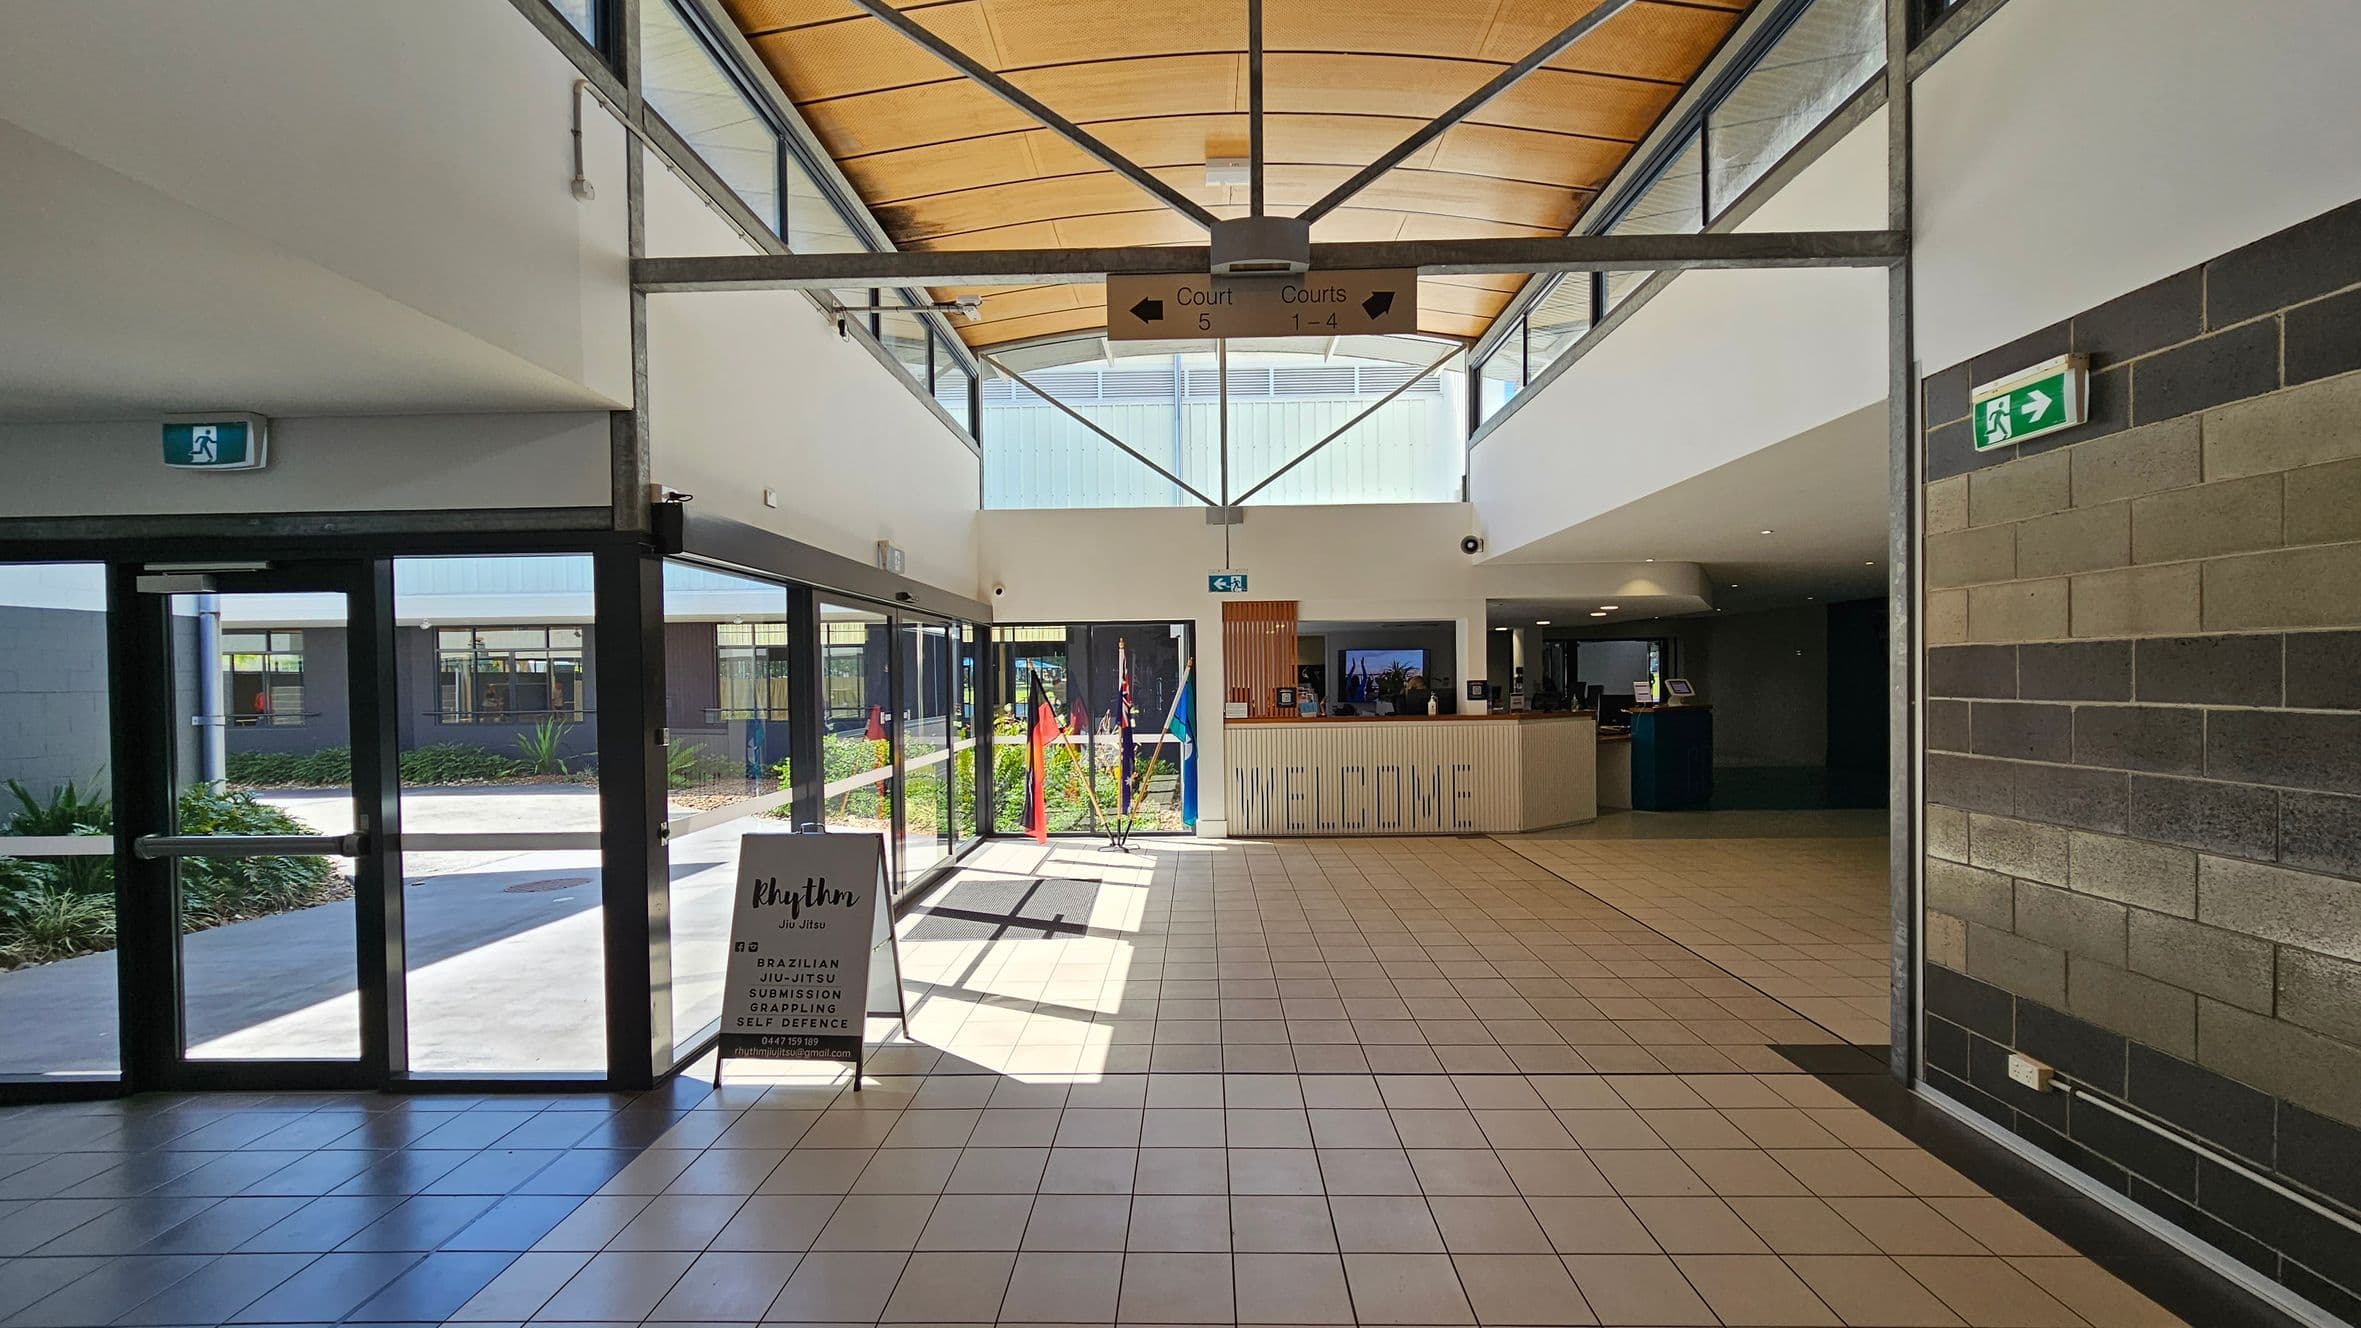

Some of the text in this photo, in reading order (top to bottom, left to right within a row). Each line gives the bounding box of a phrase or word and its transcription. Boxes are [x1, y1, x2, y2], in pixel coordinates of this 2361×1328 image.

[1177, 287, 1233, 306] Court
[1281, 285, 1347, 304] Courts
[1199, 313, 1211, 331] 5
[1292, 313, 1299, 331] 1
[1326, 312, 1338, 330] 4
[1236, 764, 1472, 830] WELCOME
[752, 877, 860, 920] Rhythm
[778, 920, 826, 930] Jiu Jitsu
[757, 958, 839, 968] BRAZILIAN
[760, 973, 836, 983] JIU-JITSU
[749, 988, 841, 999] SUBMISSION
[750, 1003, 836, 1013] GRAPPLING
[736, 1017, 848, 1029] SELF DEFENCE
[761, 1036, 819, 1047] 0447 159 189
